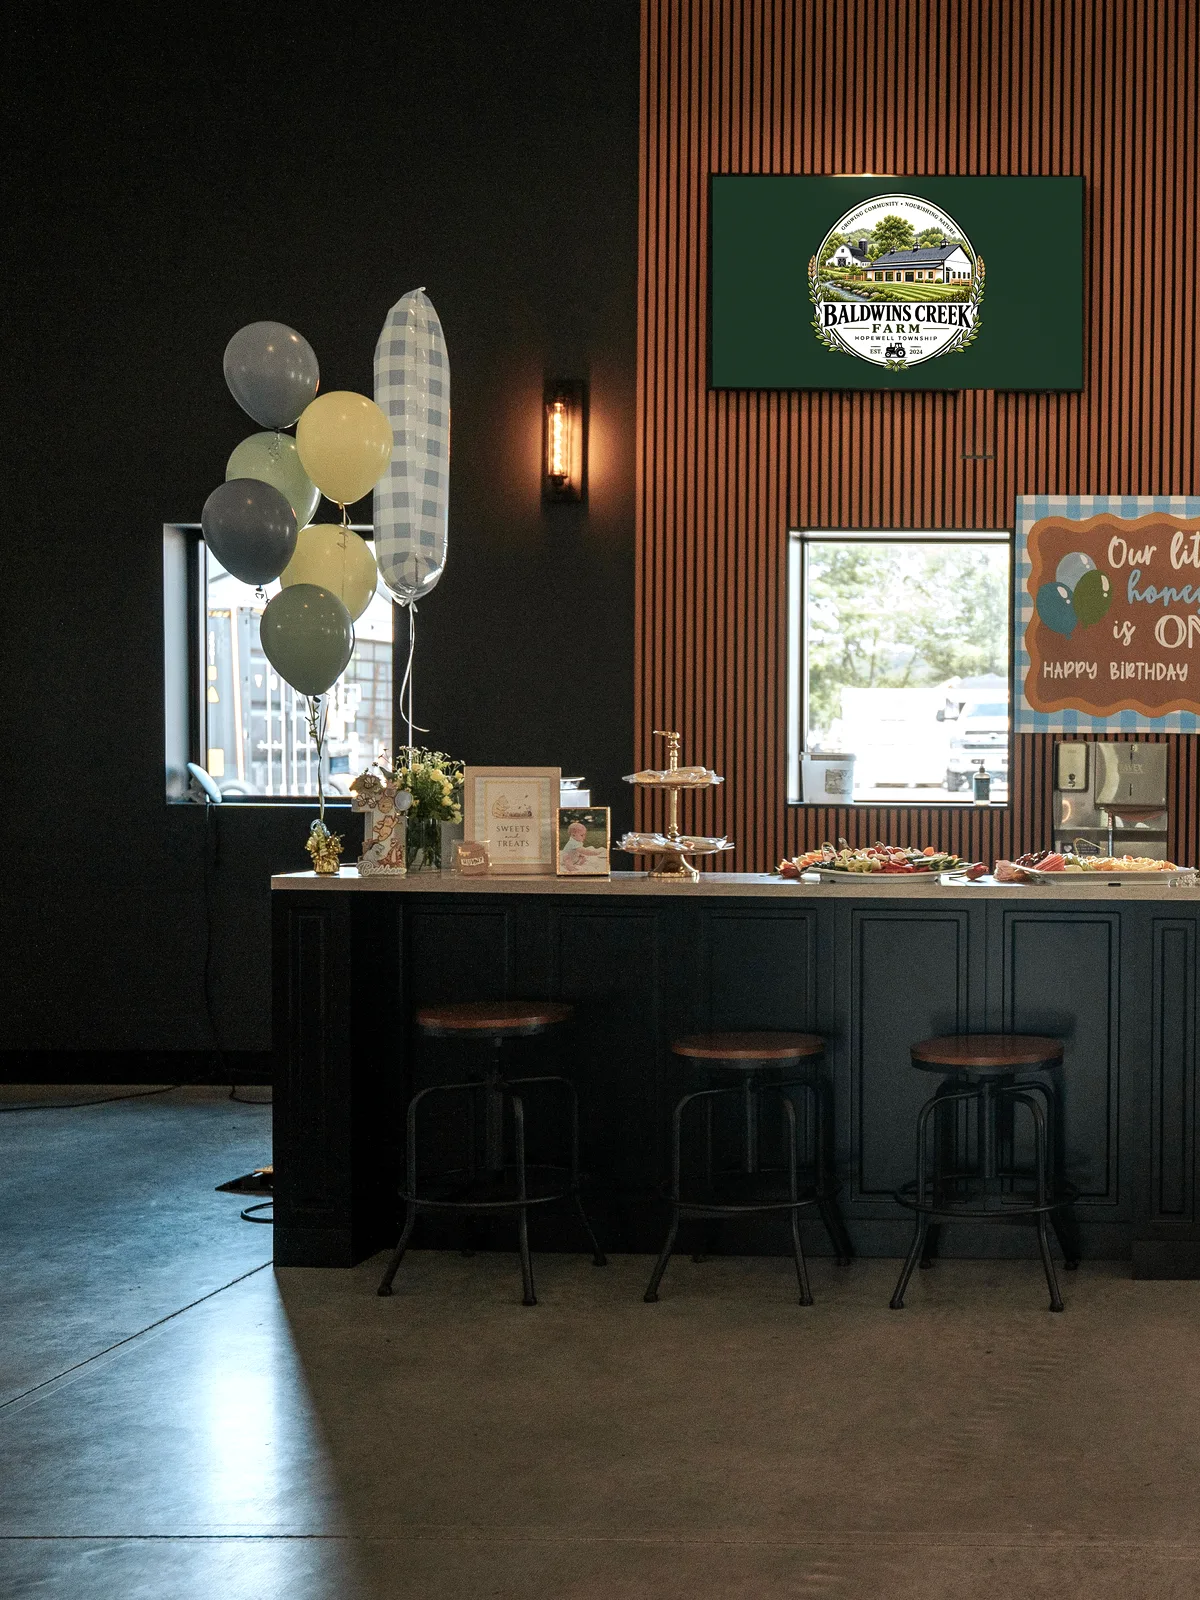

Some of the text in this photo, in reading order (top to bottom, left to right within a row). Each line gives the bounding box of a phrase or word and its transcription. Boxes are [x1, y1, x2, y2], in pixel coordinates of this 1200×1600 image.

[841, 201, 956, 235] GROWING COMMUNITY NOURISHING NATURE
[823, 304, 972, 328] BALDWINS CREEK
[871, 323, 921, 334] FARM
[1108, 535, 1157, 568] Our
[1113, 620, 1136, 646] is
[1043, 661, 1098, 680] HAPPY
[496, 825, 531, 833] SWEETS
